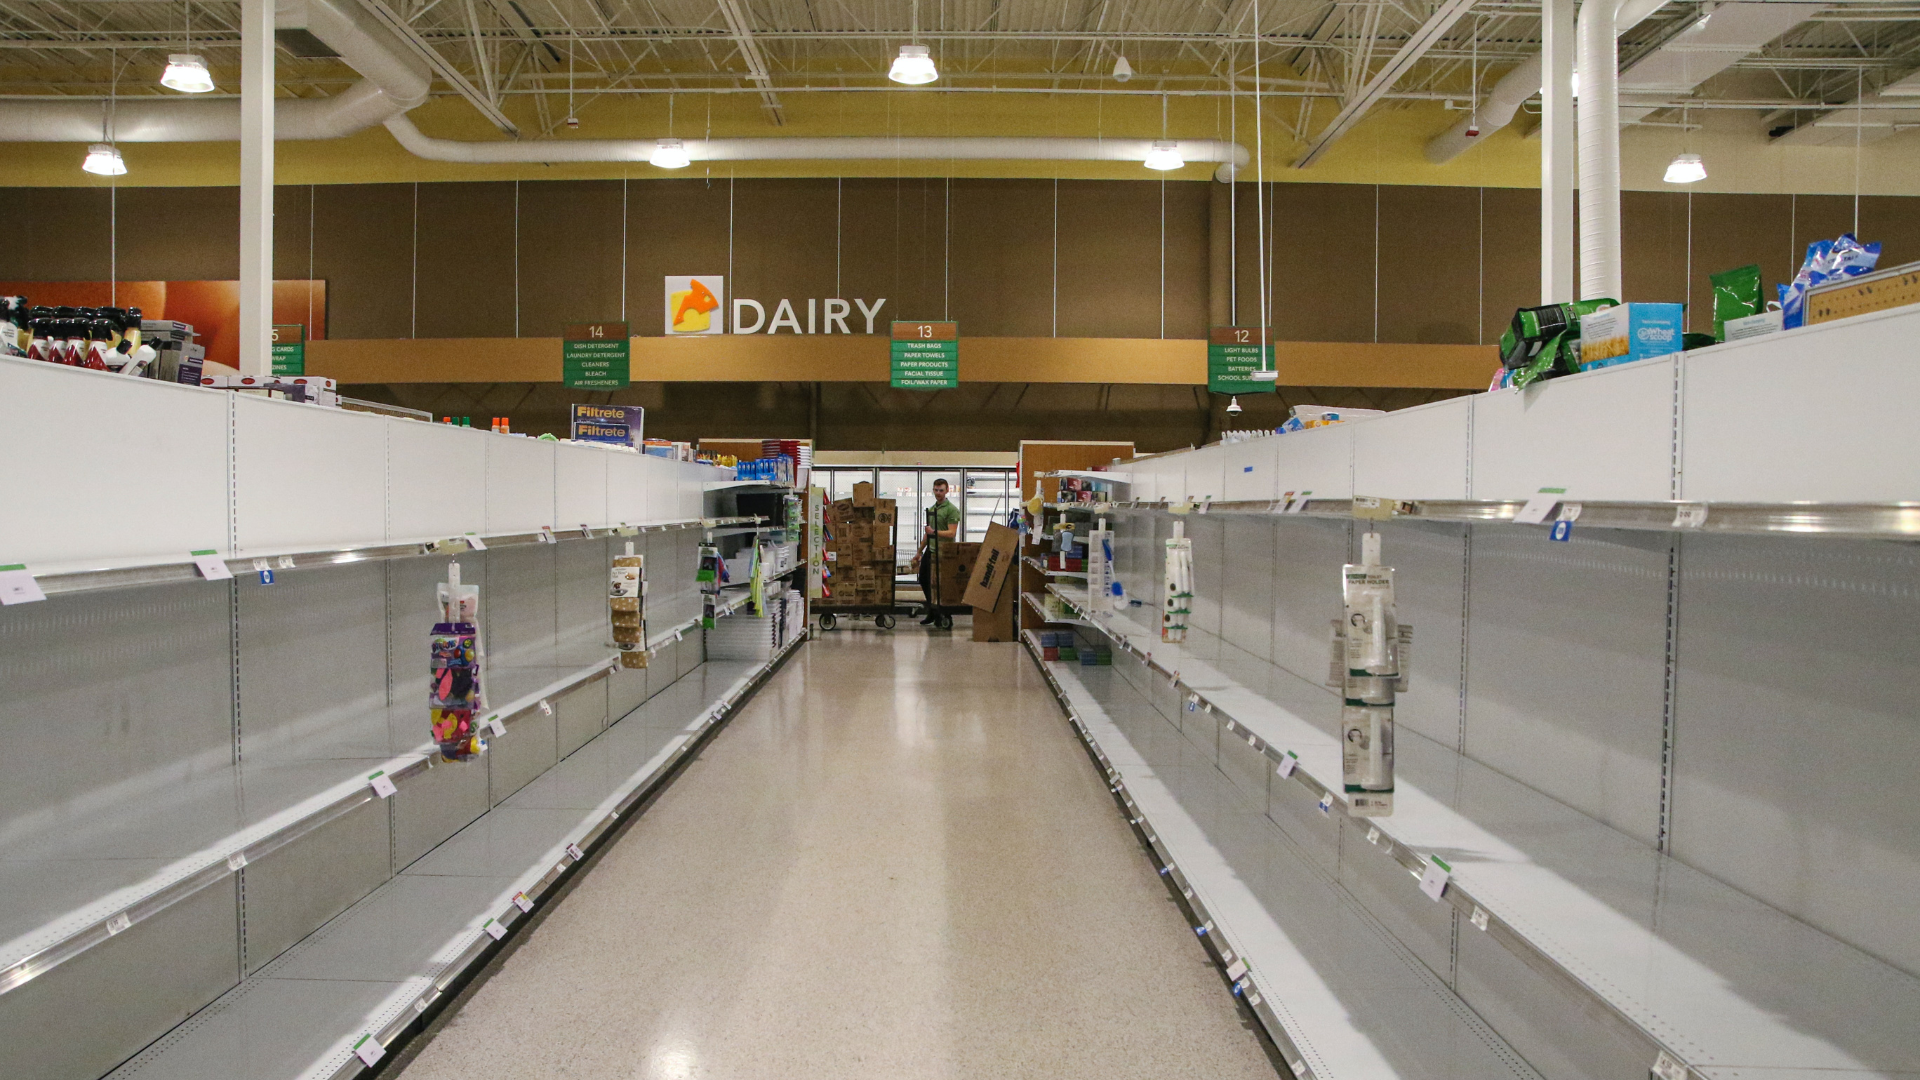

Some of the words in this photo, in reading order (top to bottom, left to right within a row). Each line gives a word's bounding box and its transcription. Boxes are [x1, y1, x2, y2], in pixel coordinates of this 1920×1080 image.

[733, 298, 886, 334] DAIRY
[272, 329, 278, 341] 5
[589, 326, 604, 338] 14
[918, 326, 932, 338] 13
[1234, 330, 1249, 342] 12
[577, 406, 625, 418] Filtrete
[578, 424, 626, 437] Filtrete
